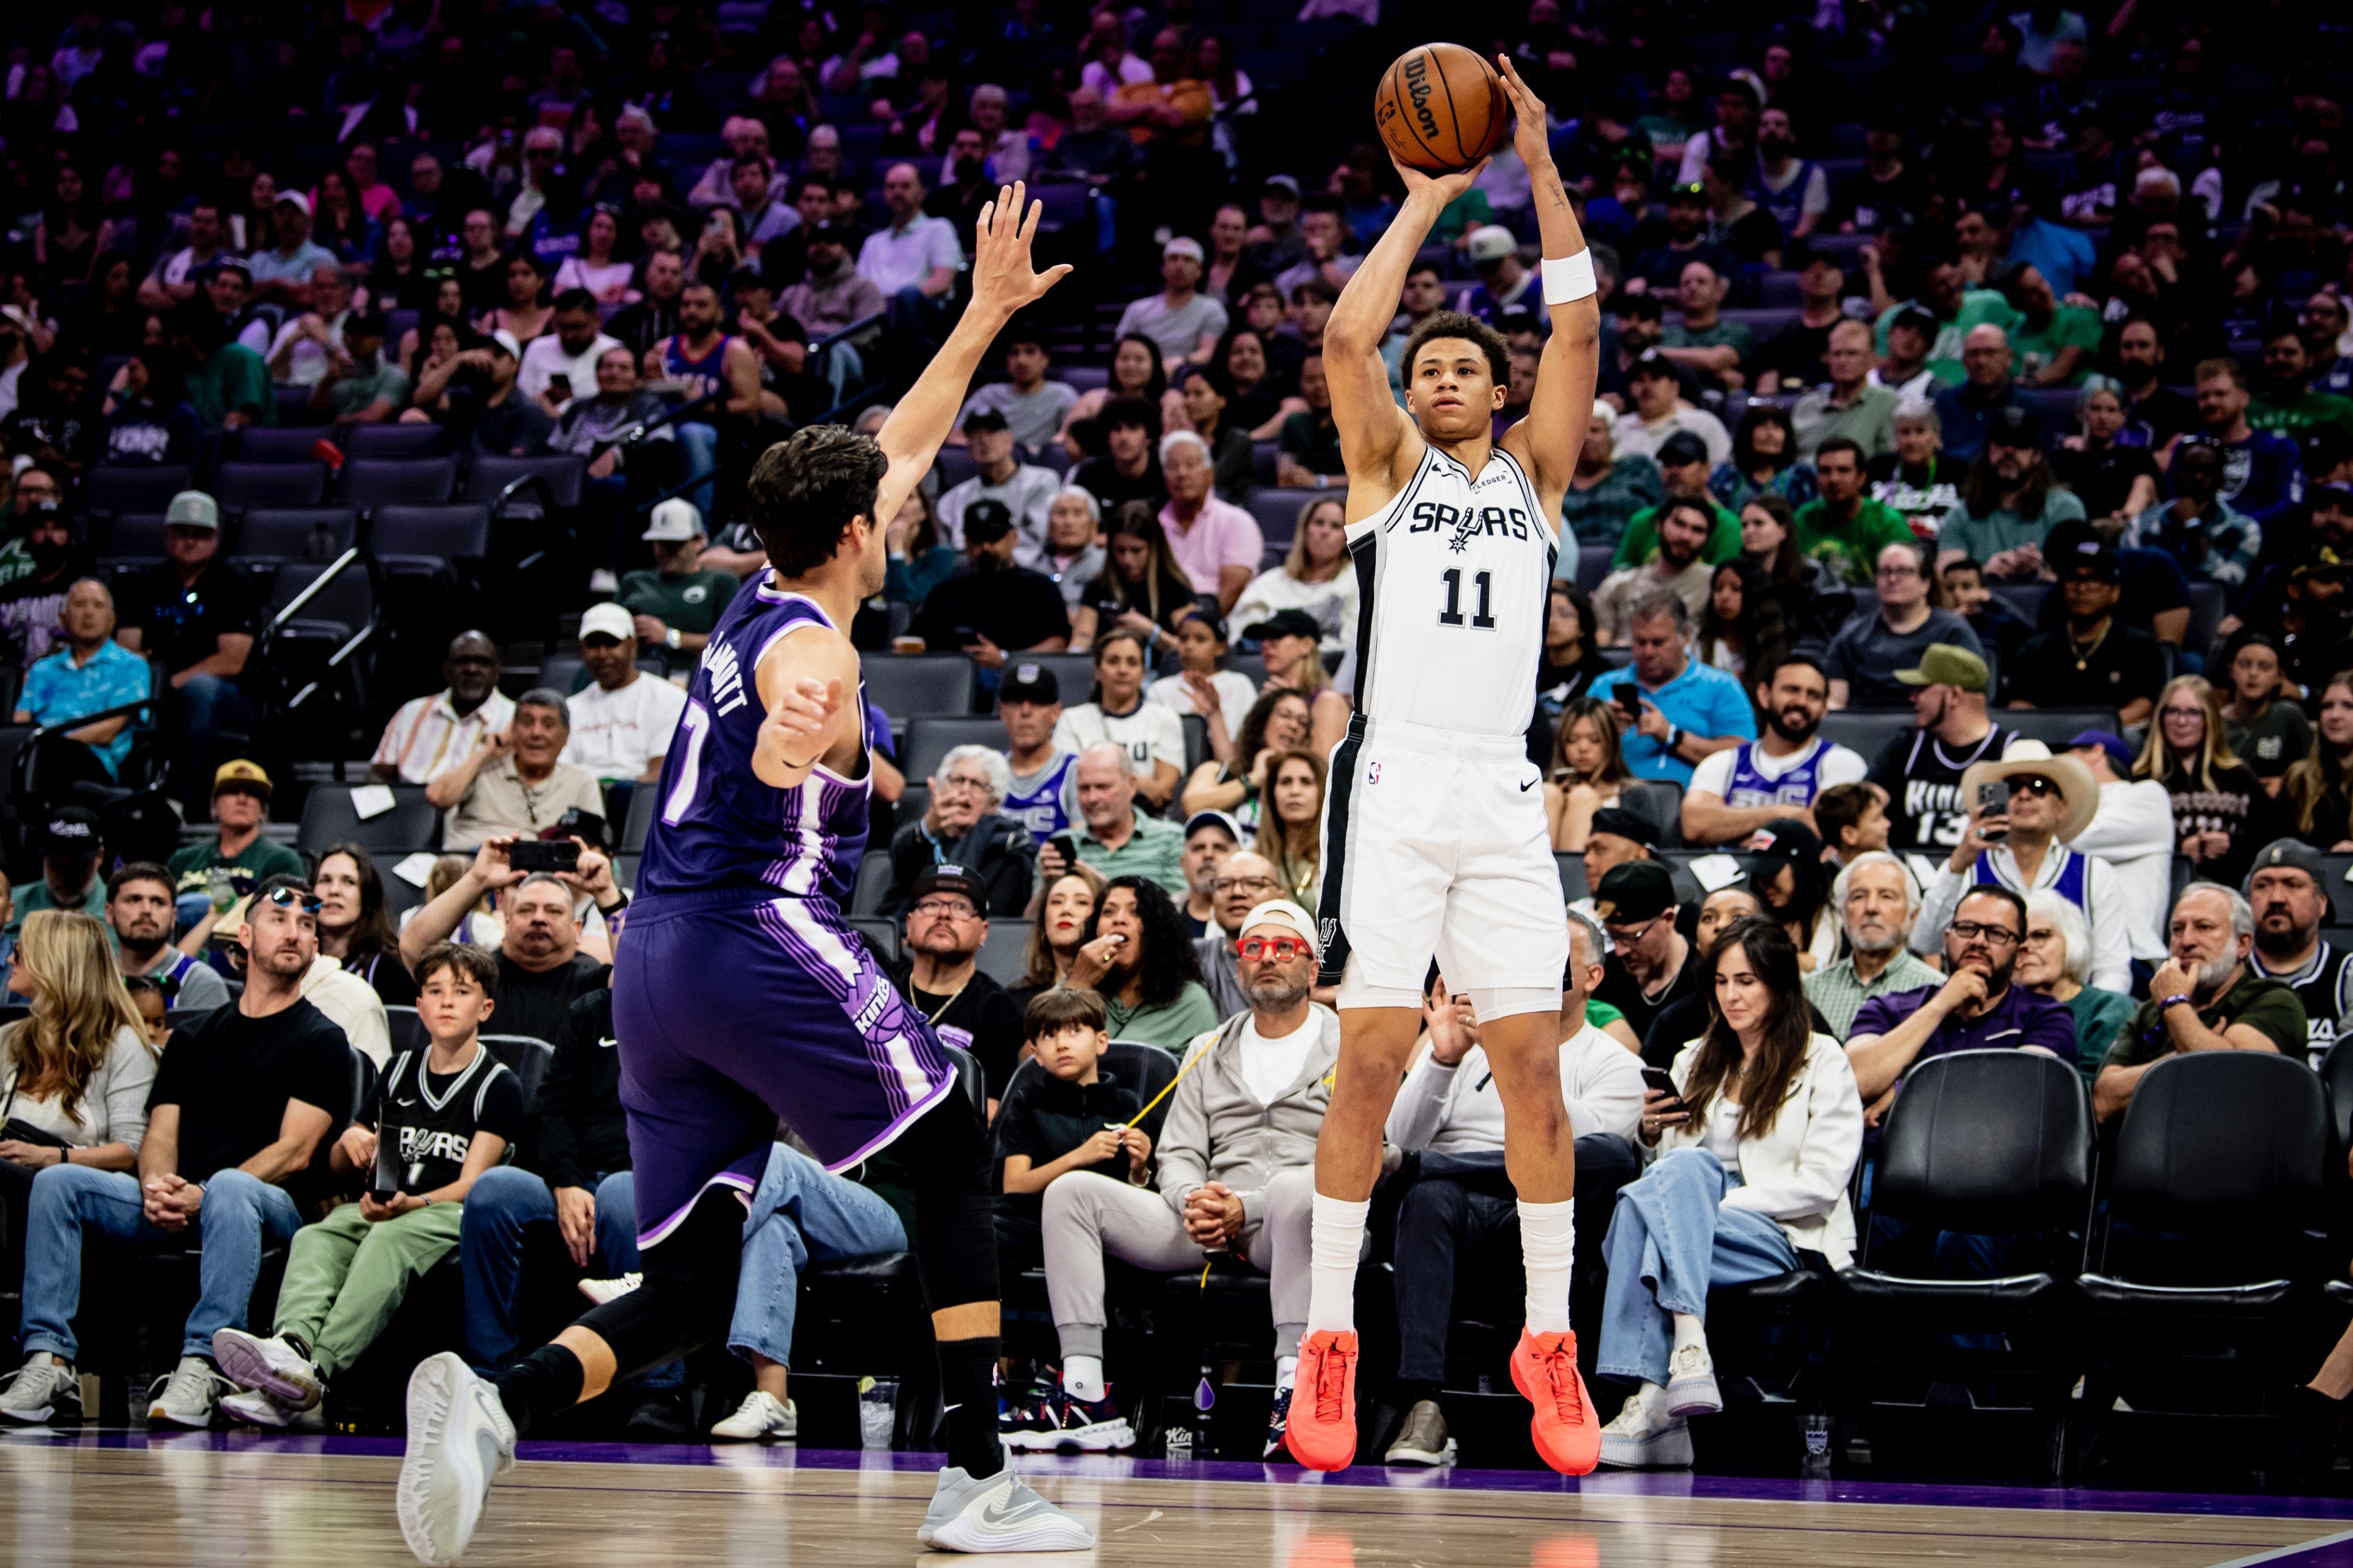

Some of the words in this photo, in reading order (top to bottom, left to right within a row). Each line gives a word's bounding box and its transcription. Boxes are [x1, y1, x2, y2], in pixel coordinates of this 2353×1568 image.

[1404, 55, 1440, 141] Wilson
[1477, 475, 1507, 489] LEDGER
[1410, 502, 1527, 543] SPURS
[1437, 566, 1497, 632] 11
[661, 696, 710, 828] 7
[854, 975, 890, 1035] KINGS
[399, 1126, 469, 1164] PURS
